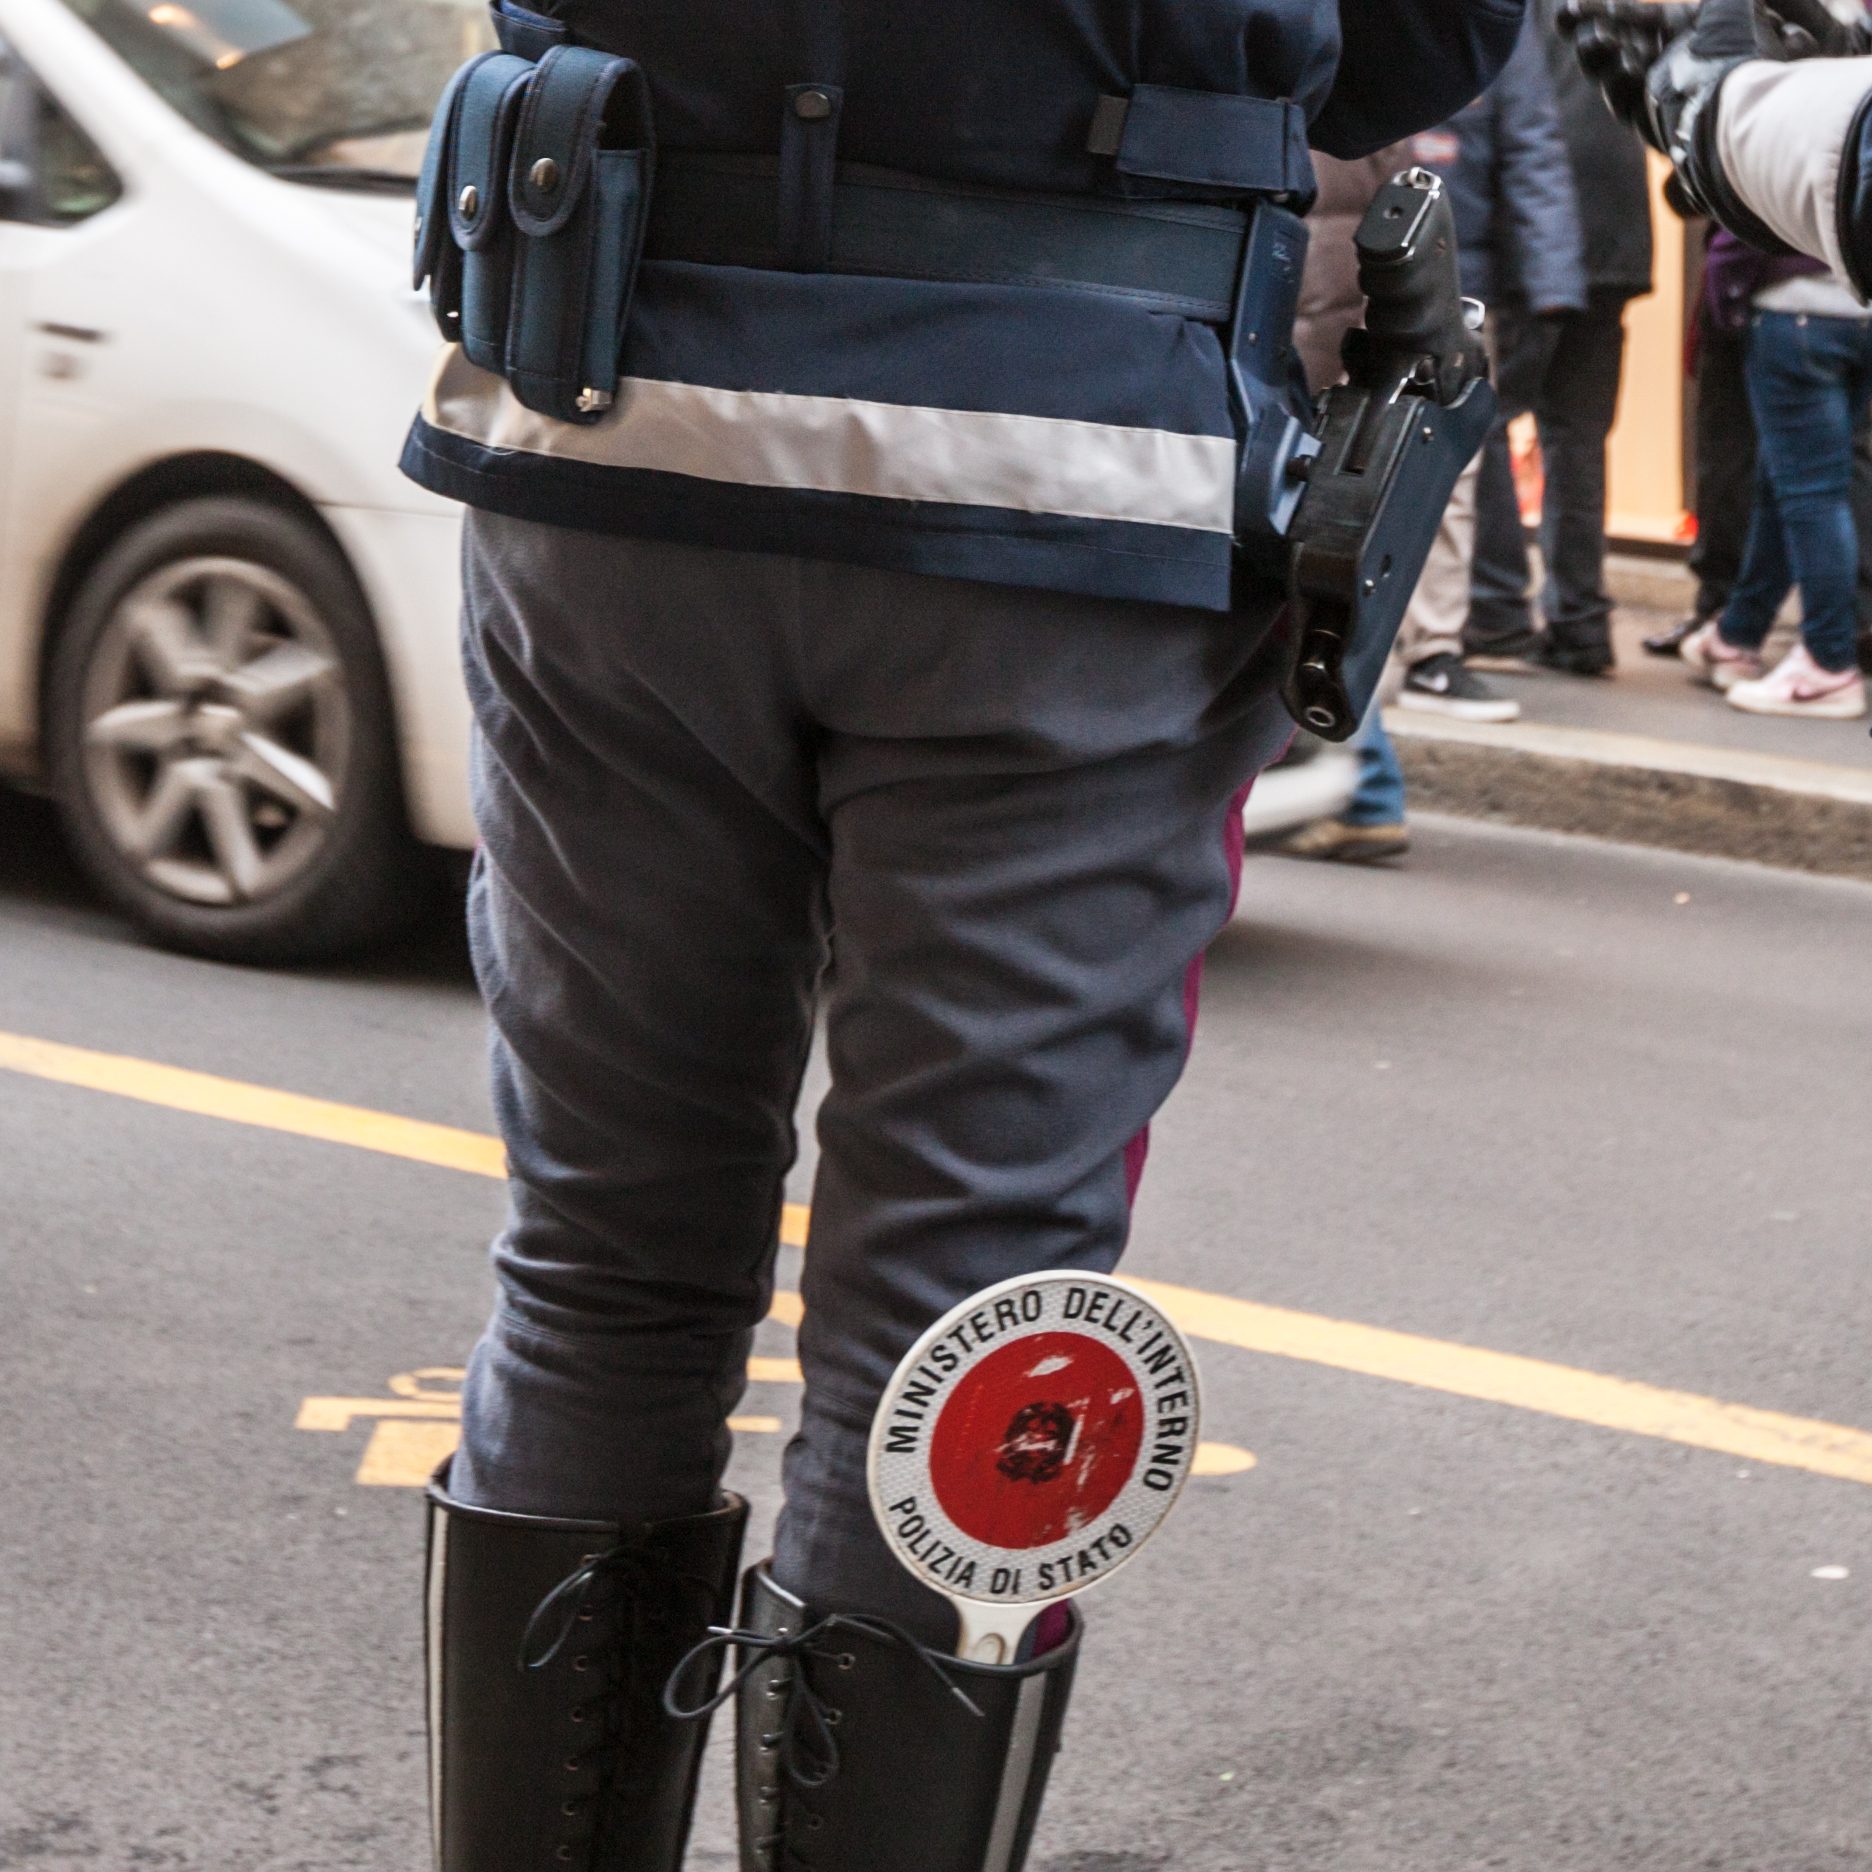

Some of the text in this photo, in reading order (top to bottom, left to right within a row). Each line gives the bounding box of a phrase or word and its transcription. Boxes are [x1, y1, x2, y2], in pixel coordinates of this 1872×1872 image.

[885, 1287, 1189, 1493] MINISTERO DELL'INTERNO
[889, 1496, 1134, 1596] POLIZIA DI STATO
